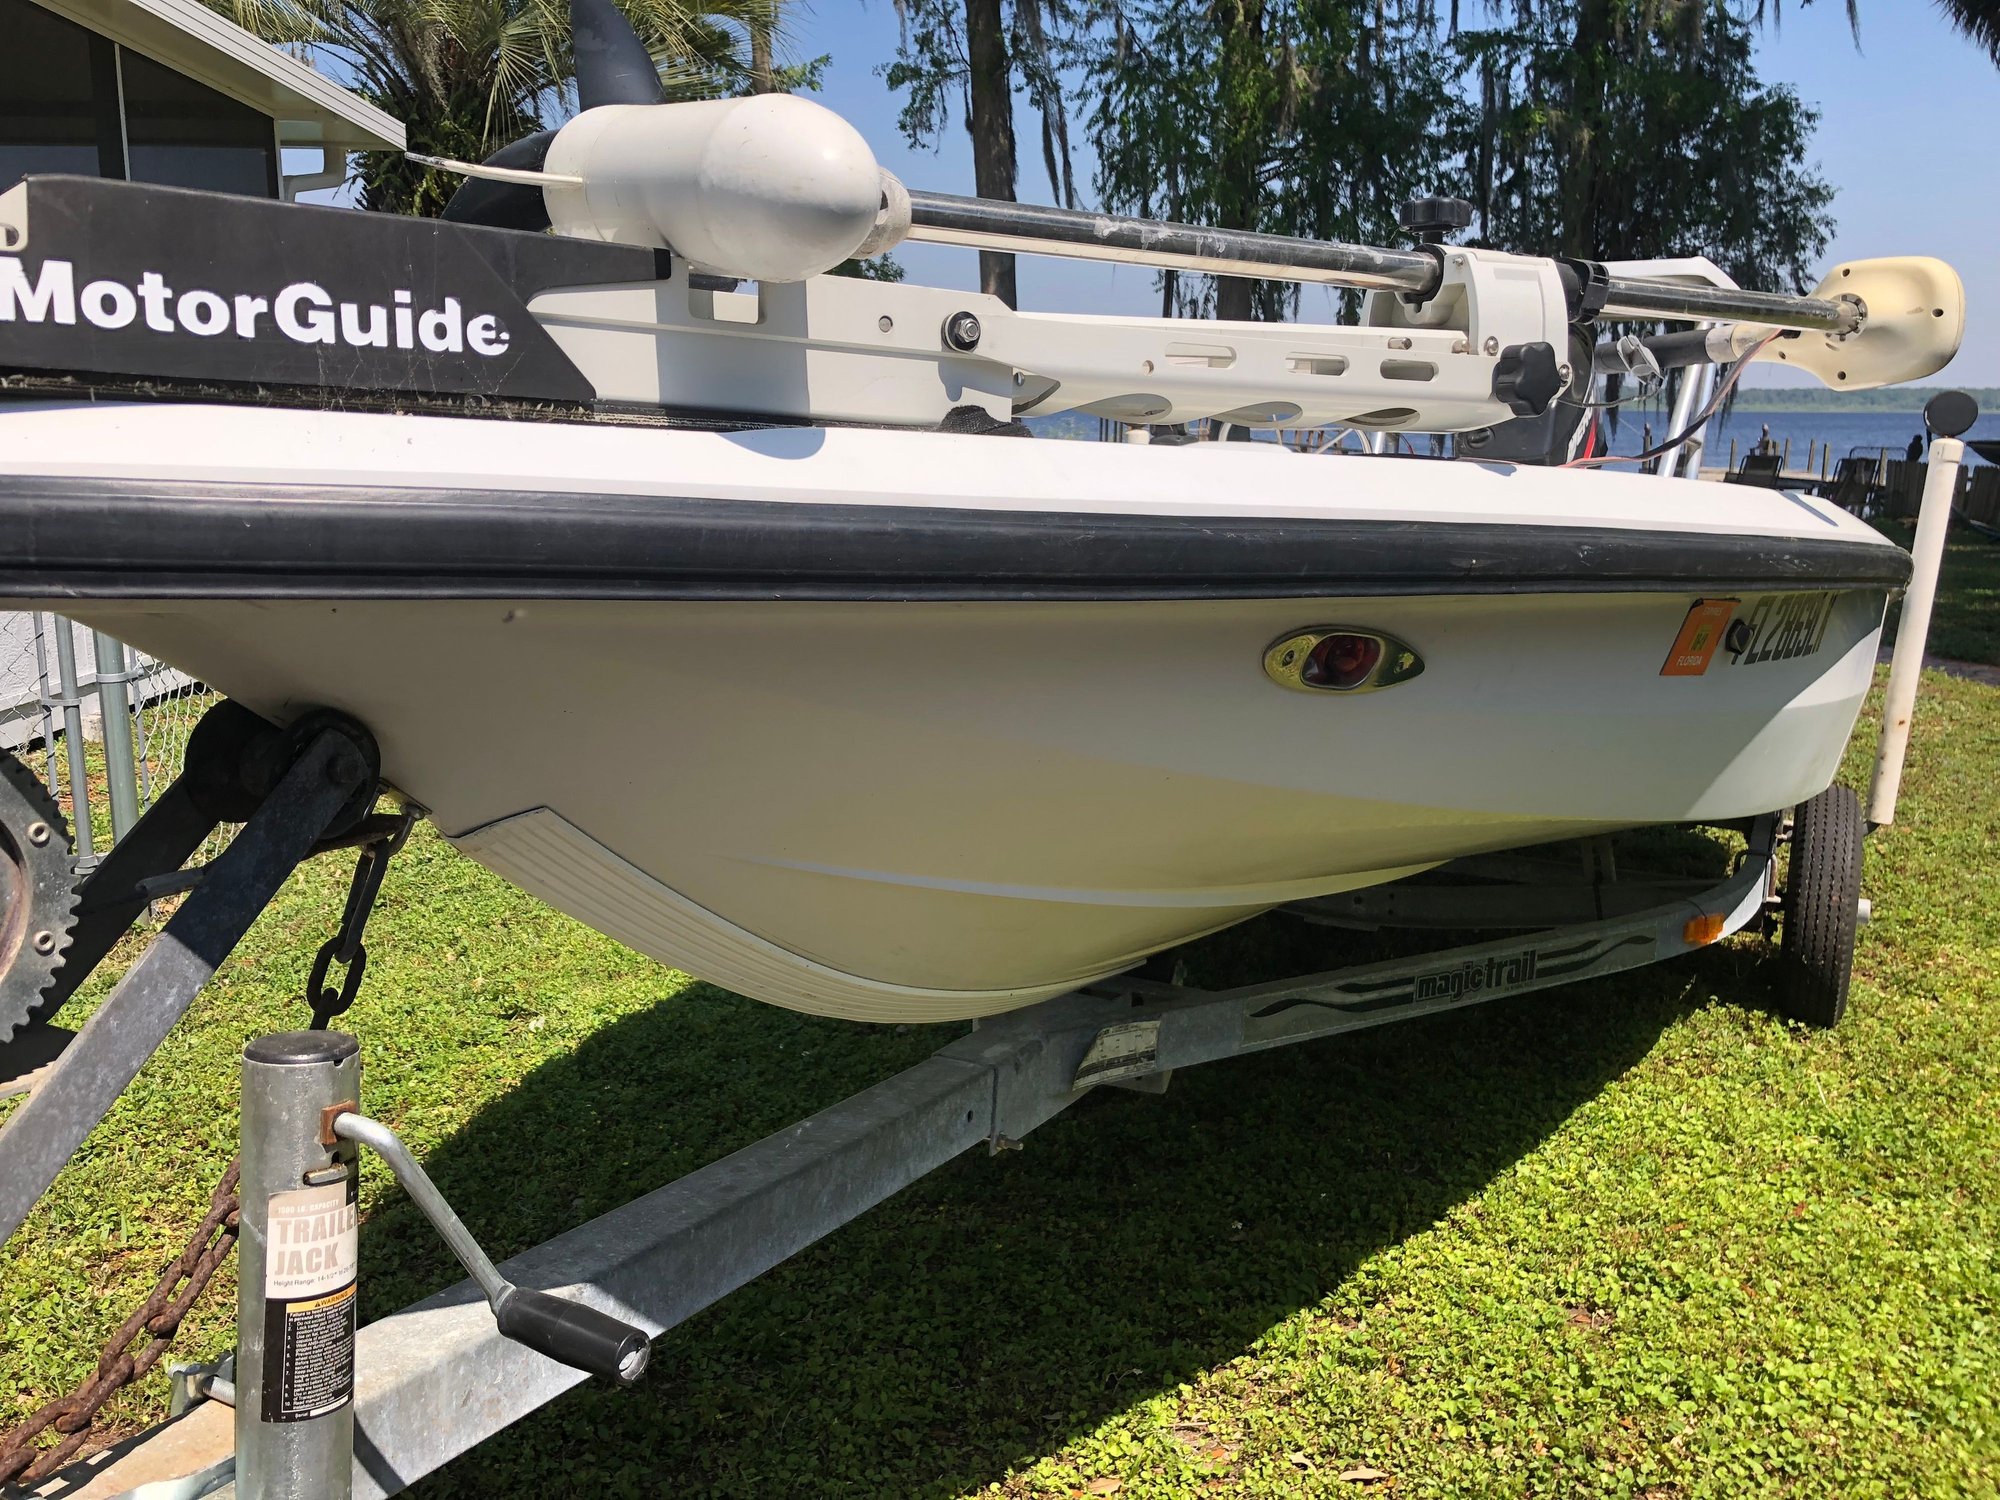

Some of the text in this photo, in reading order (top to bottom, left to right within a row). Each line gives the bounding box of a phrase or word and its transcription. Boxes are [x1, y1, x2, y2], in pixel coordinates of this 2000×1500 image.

[0, 257, 510, 356] MotorGuide
[276, 1206, 357, 1245] TRAILE
[274, 1242, 339, 1276] JACK
